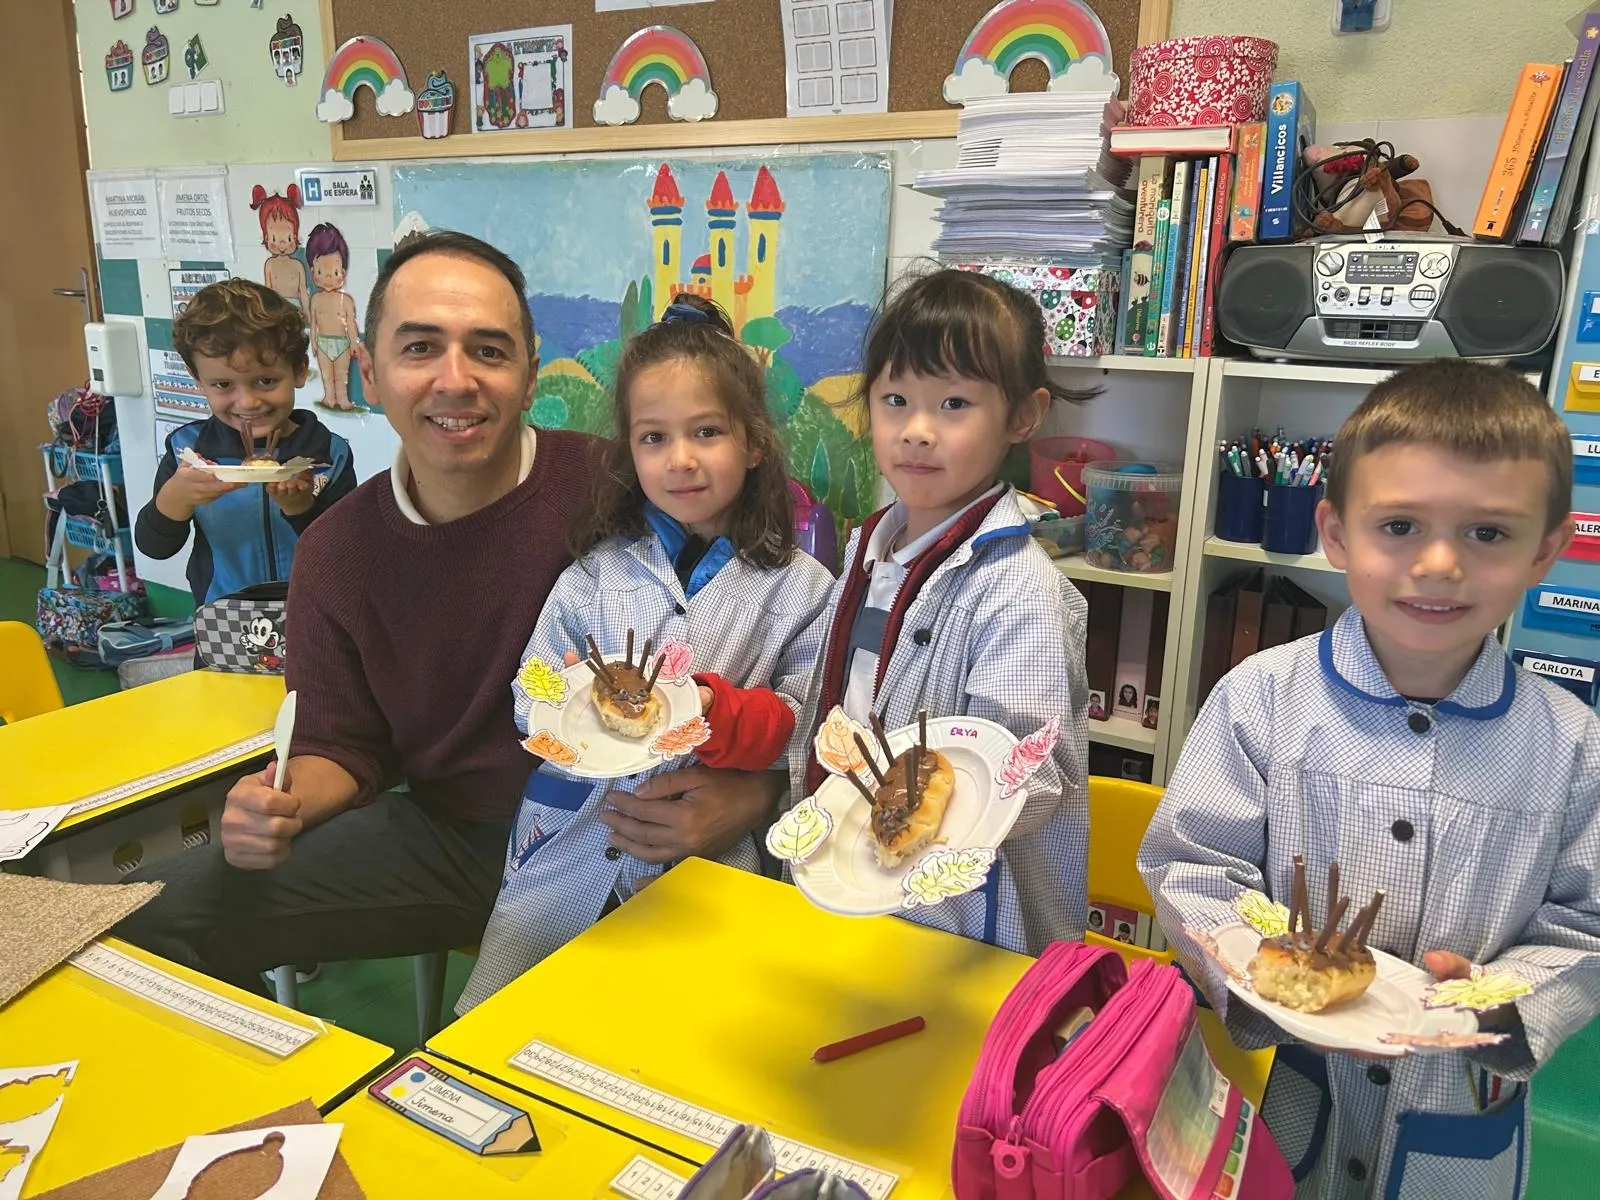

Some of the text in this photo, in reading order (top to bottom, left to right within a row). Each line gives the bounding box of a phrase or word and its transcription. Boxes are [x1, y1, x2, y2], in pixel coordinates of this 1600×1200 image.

[1271, 124, 1287, 195] Villancicos
[176, 208, 211, 216] FRUTOS SECOS
[1137, 180, 1148, 233] aventurera
[1147, 173, 1160, 236] La mariquita
[1552, 596, 1600, 611] MARINA
[1532, 661, 1583, 678] CARLOTA
[428, 1083, 463, 1104] JIMENA
[411, 1097, 455, 1124] Jimena
[781, 1150, 790, 1158] 8
[641, 1177, 651, 1185] 2
[653, 1183, 663, 1192] 3
[666, 1190, 674, 1198] 4
